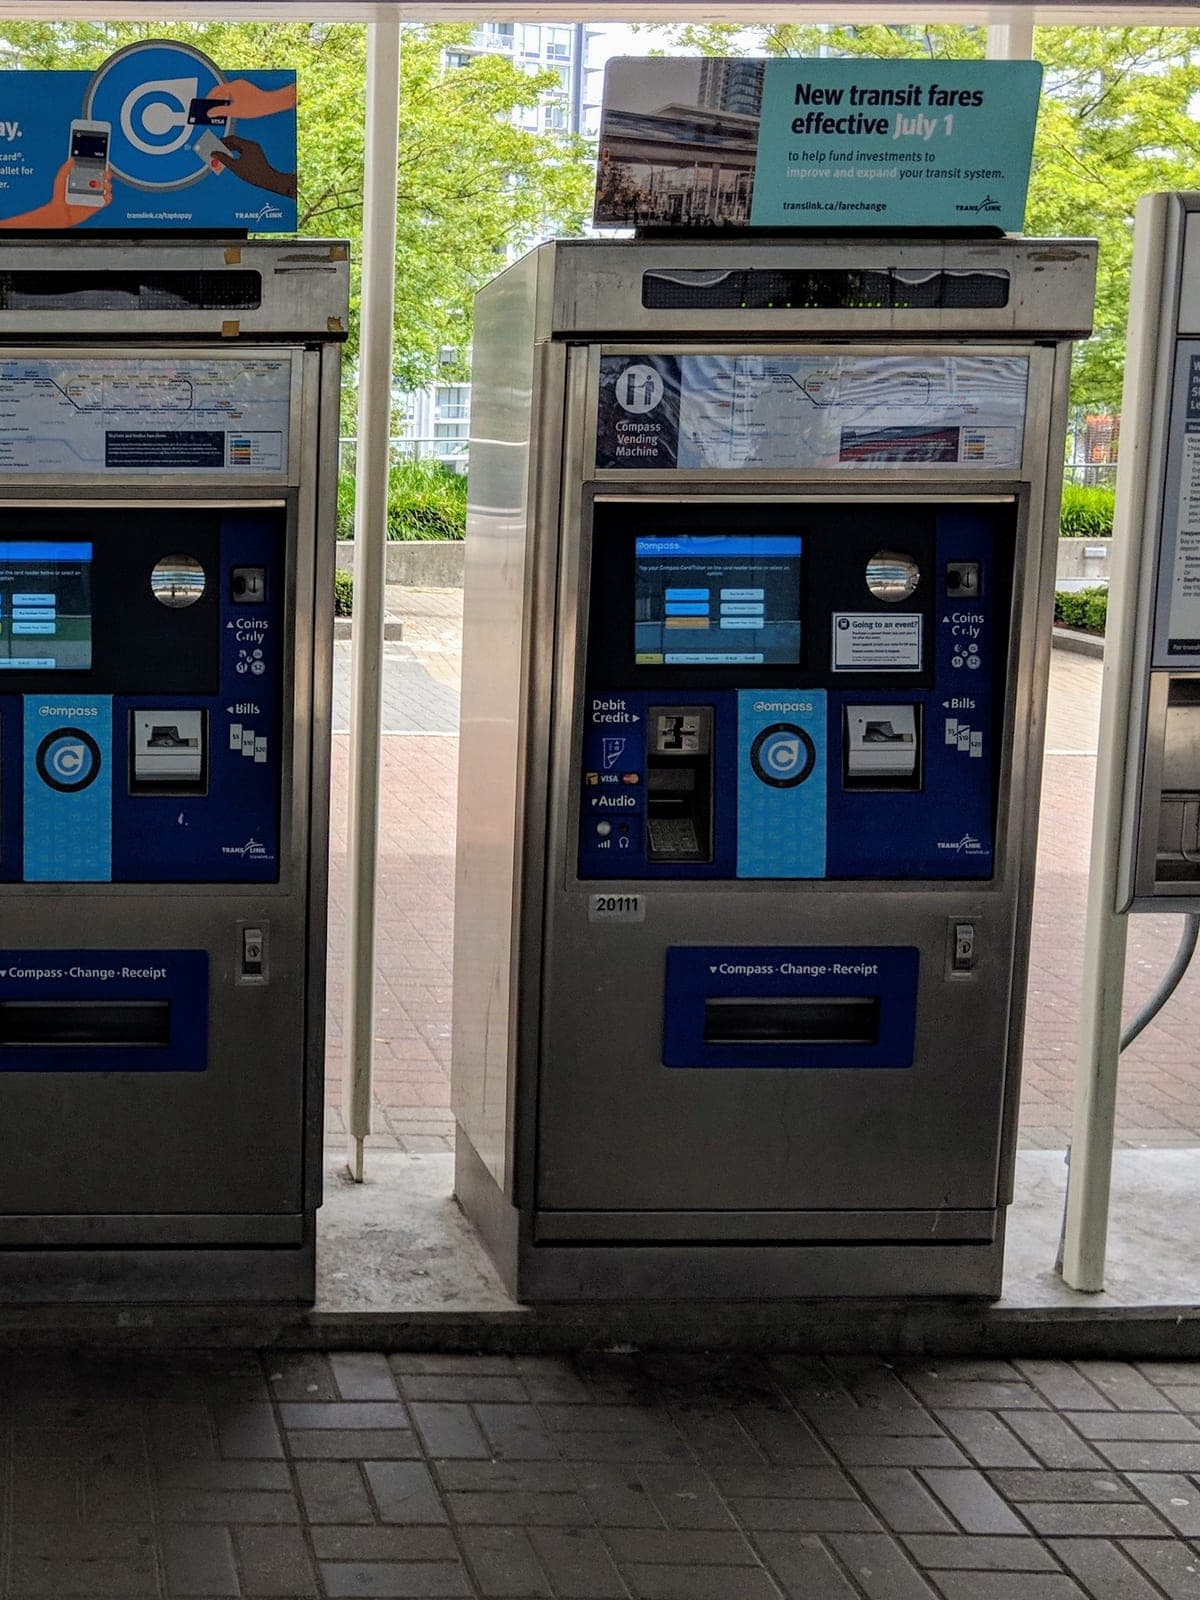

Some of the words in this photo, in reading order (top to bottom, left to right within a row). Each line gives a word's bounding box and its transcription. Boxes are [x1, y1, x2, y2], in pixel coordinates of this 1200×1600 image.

[794, 83, 842, 105] New
[850, 84, 921, 106] transit
[928, 84, 984, 106] fares
[792, 112, 888, 134] effective
[892, 113, 936, 140] July
[944, 114, 954, 135] 1
[788, 152, 799, 160] to
[802, 150, 826, 163] help
[829, 150, 853, 161] fund
[856, 151, 921, 162] investments
[924, 153, 935, 162] to
[21, 167, 33, 175] for
[787, 168, 831, 179] improve
[834, 167, 854, 177] and
[857, 168, 897, 180] expand
[899, 170, 922, 180] your
[926, 168, 961, 179] transit
[964, 169, 1004, 180] system.
[783, 201, 886, 212] translink.ca/farechange
[616, 421, 661, 434] Compass
[617, 434, 658, 446] Vending
[616, 446, 658, 457] Machine
[236, 618, 268, 629] Coins
[952, 613, 984, 624] Coins
[852, 621, 873, 629] Going
[235, 704, 260, 714] Bills
[593, 699, 626, 710] Debit
[753, 701, 812, 713] Compass
[951, 698, 976, 709] Bills
[38, 706, 98, 717] Compass
[593, 712, 629, 723] Credit
[599, 795, 636, 806] Audio
[596, 898, 638, 912] 20111
[8, 967, 62, 980] Compass
[68, 967, 115, 980] Change
[122, 967, 166, 979] Receipt
[719, 963, 773, 976] Compass
[780, 963, 826, 976] Change
[833, 964, 878, 976] Receipt
